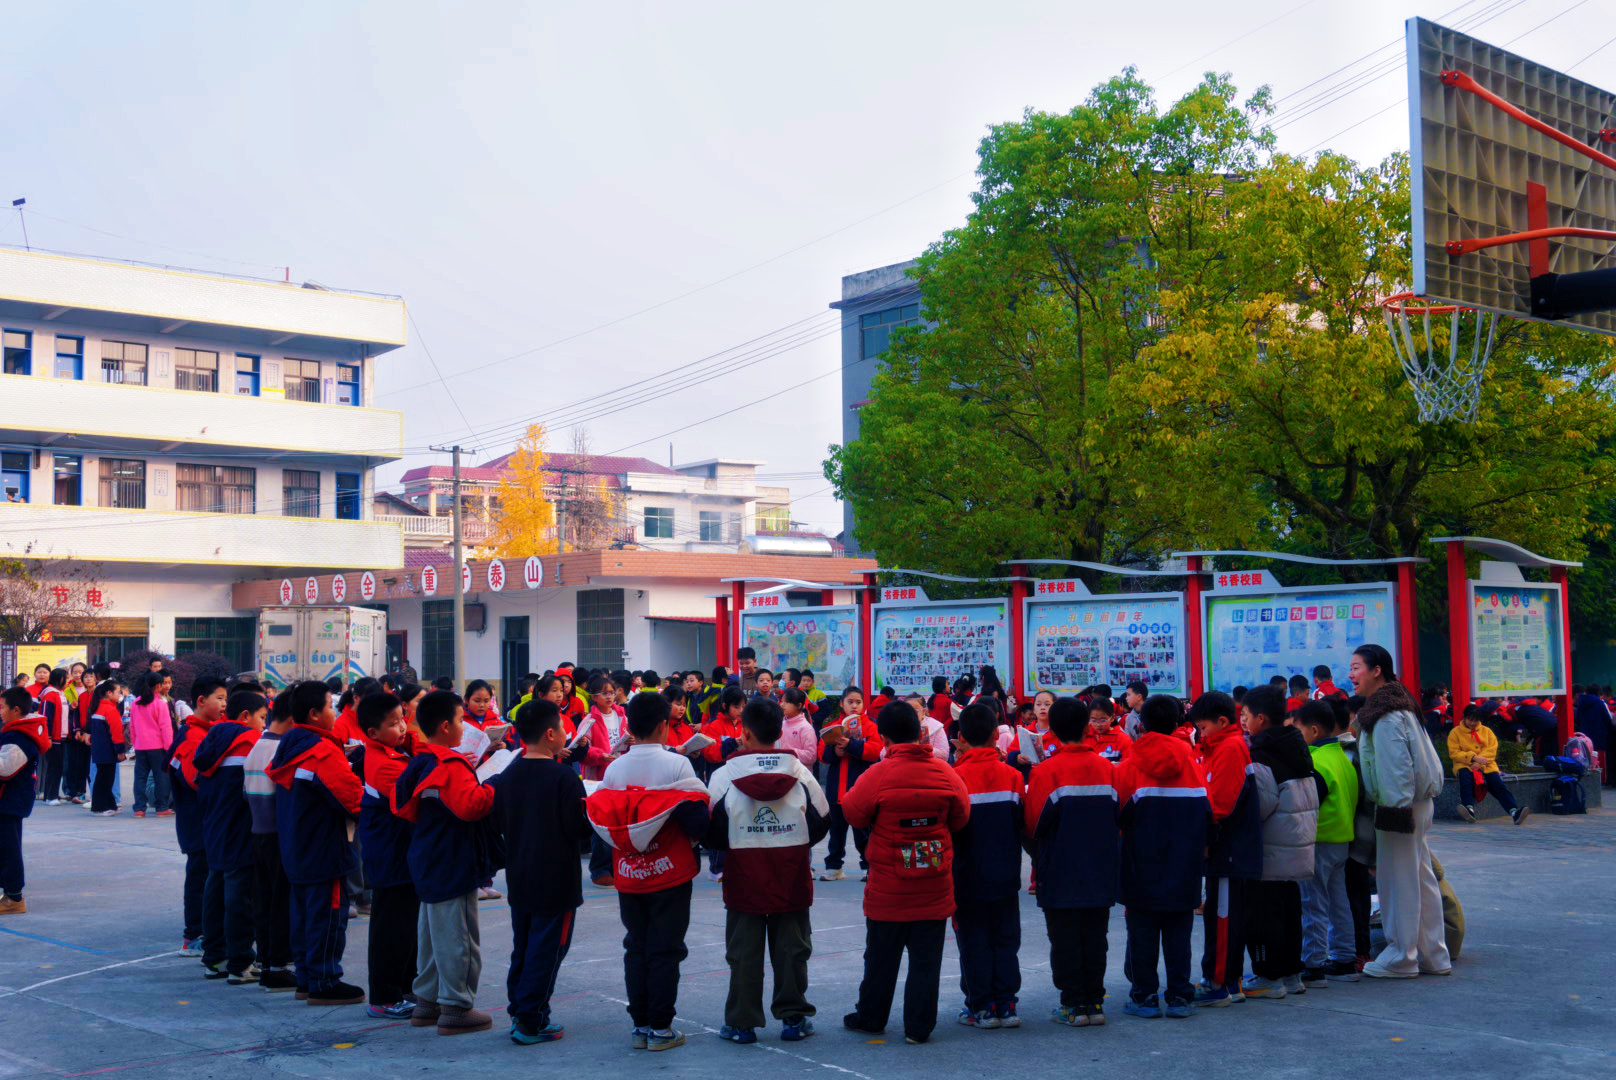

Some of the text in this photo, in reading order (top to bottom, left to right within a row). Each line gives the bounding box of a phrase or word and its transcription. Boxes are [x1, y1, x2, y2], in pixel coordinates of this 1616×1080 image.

[1038, 581, 1076, 593] 书香校园
[1218, 572, 1262, 587] 书香校园
[281, 574, 373, 601] 食品安全
[885, 588, 917, 600] 书香校园
[53, 585, 104, 607] 节电
[751, 595, 779, 607] 书香校园
[901, 839, 943, 869] YES
